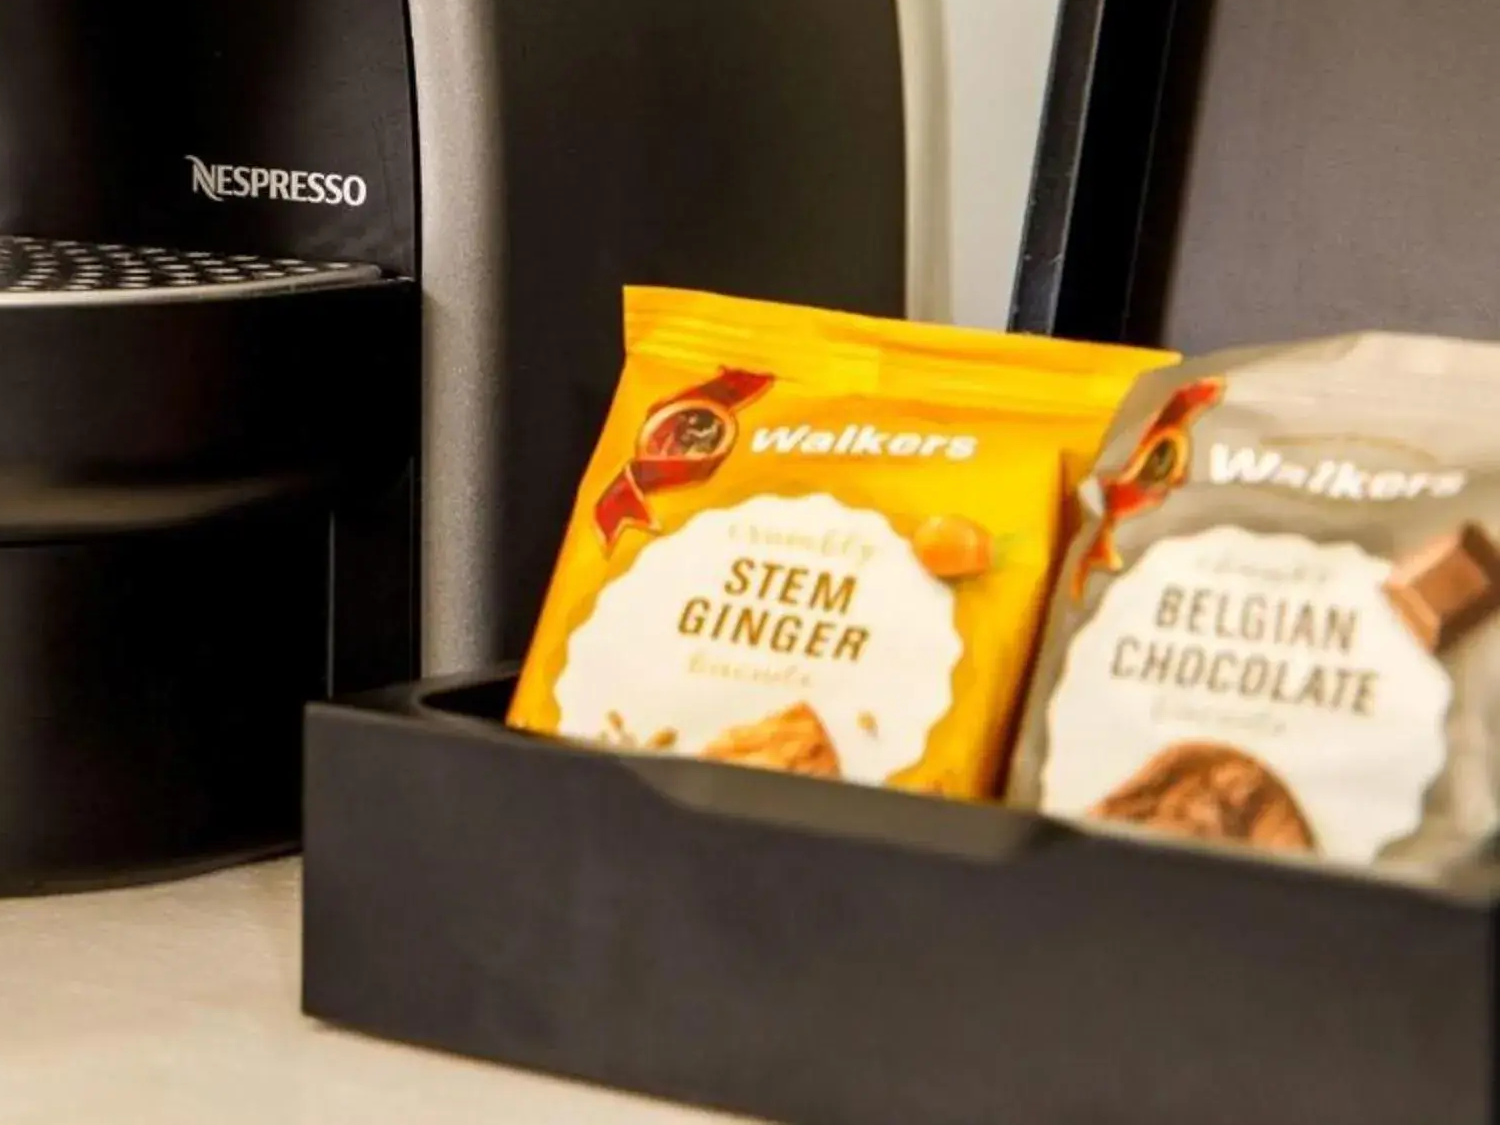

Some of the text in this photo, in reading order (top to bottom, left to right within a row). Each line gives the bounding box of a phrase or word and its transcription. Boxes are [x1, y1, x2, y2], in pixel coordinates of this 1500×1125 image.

[185, 155, 367, 206] NESPRESSO
[751, 424, 978, 460] Walkers
[723, 557, 856, 616] STEM
[1154, 582, 1357, 654] BELGIAN
[677, 595, 870, 662] GINGER
[1109, 634, 1379, 716] CHOCOLATE
